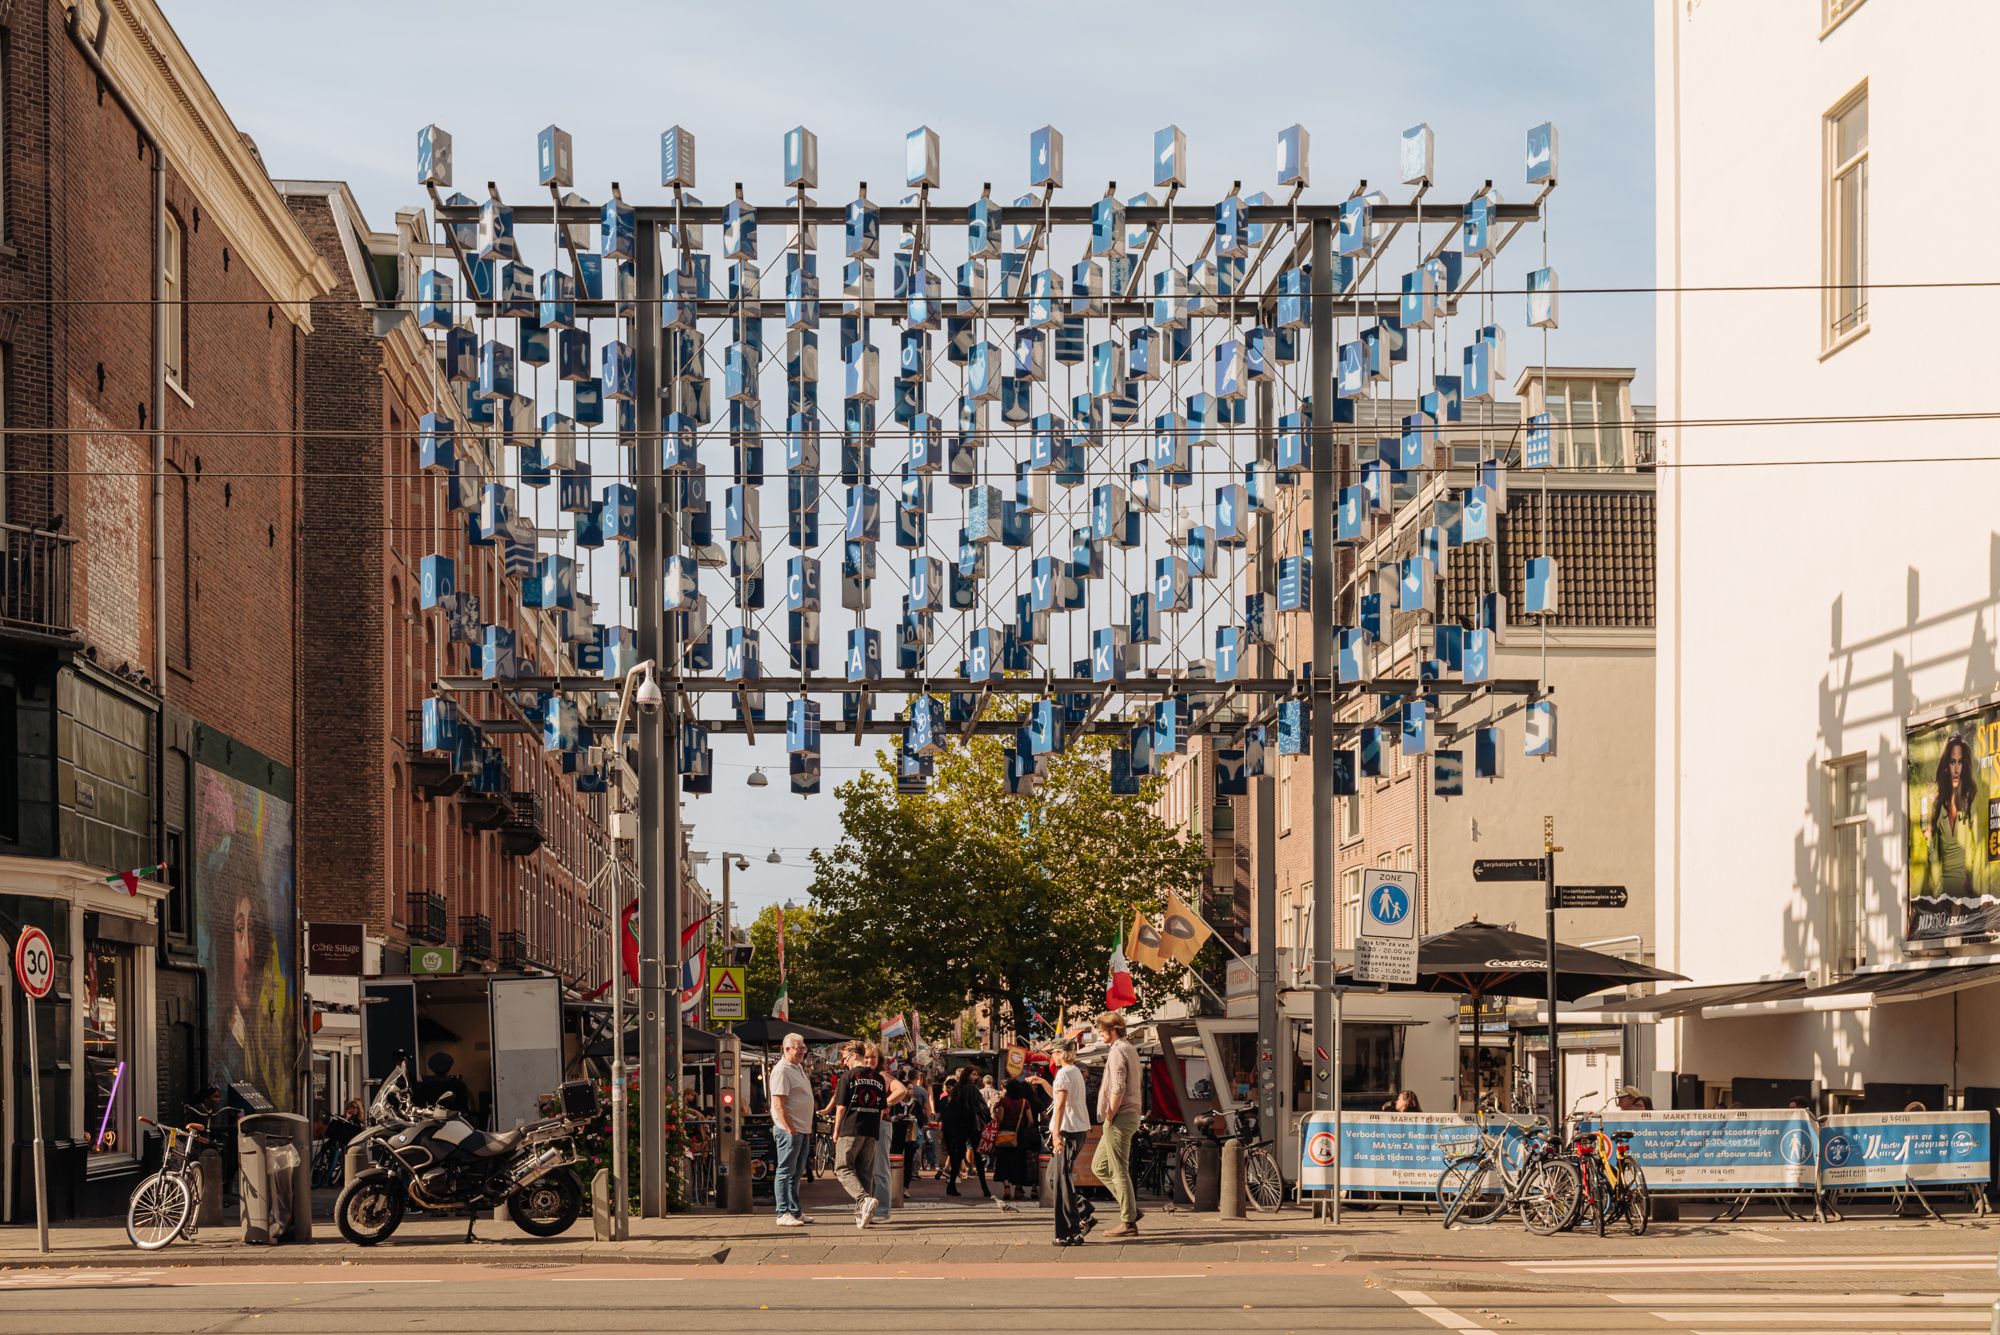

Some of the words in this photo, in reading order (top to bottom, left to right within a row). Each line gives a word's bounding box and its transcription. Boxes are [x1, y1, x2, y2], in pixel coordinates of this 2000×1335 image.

[1379, 873, 1403, 882] ZONE
[27, 949, 48, 975] 30
[1390, 1115, 1418, 1123] MARKT
[1421, 1116, 1454, 1124] TERREIN
[1345, 1129, 1386, 1138] Verboden
[1408, 1131, 1438, 1140] fietsers
[1724, 1128, 1780, 1137] scooterrijders
[1372, 1142, 1386, 1150] MA
[1387, 1142, 1402, 1150] t/m
[1354, 1152, 1369, 1160] dus
[1370, 1153, 1385, 1161] ook
[1387, 1153, 1414, 1162] tijdens
[1642, 1151, 1658, 1160] ook
[1715, 1149, 1746, 1158] afbouw
[1747, 1150, 1772, 1158] markt
